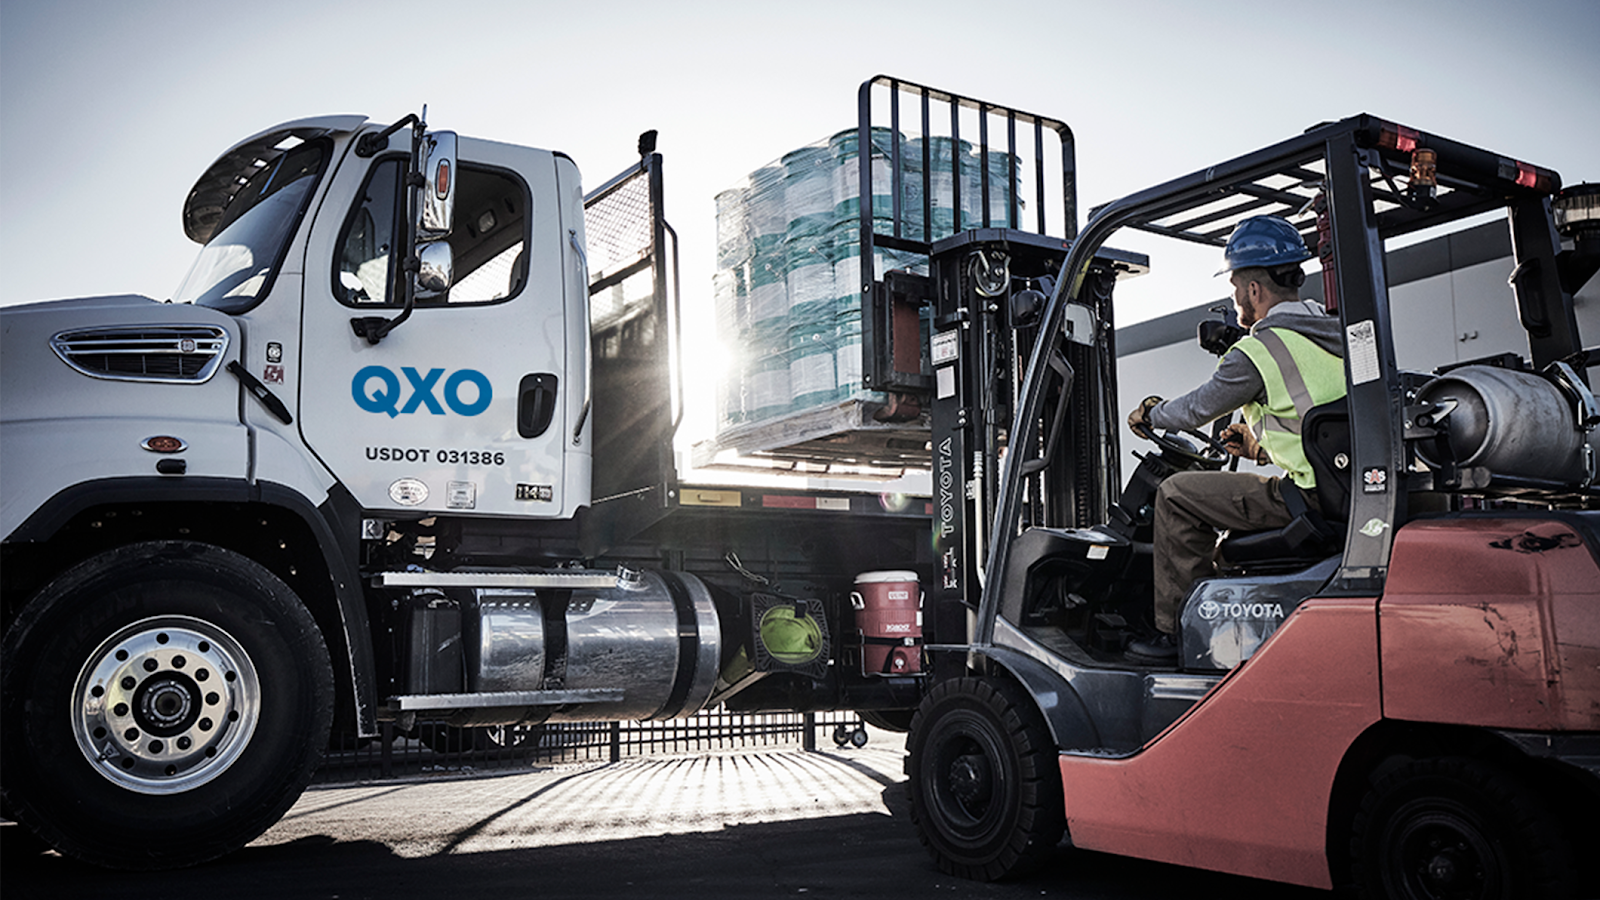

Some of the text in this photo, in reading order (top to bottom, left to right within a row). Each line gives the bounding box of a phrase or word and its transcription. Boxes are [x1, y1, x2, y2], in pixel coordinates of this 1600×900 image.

[352, 365, 493, 419] QXO
[366, 447, 505, 466] USDOT 031386
[1364, 469, 1386, 484] SAS
[938, 437, 955, 538] TOYOTA
[1223, 603, 1284, 620] TOYOTA
